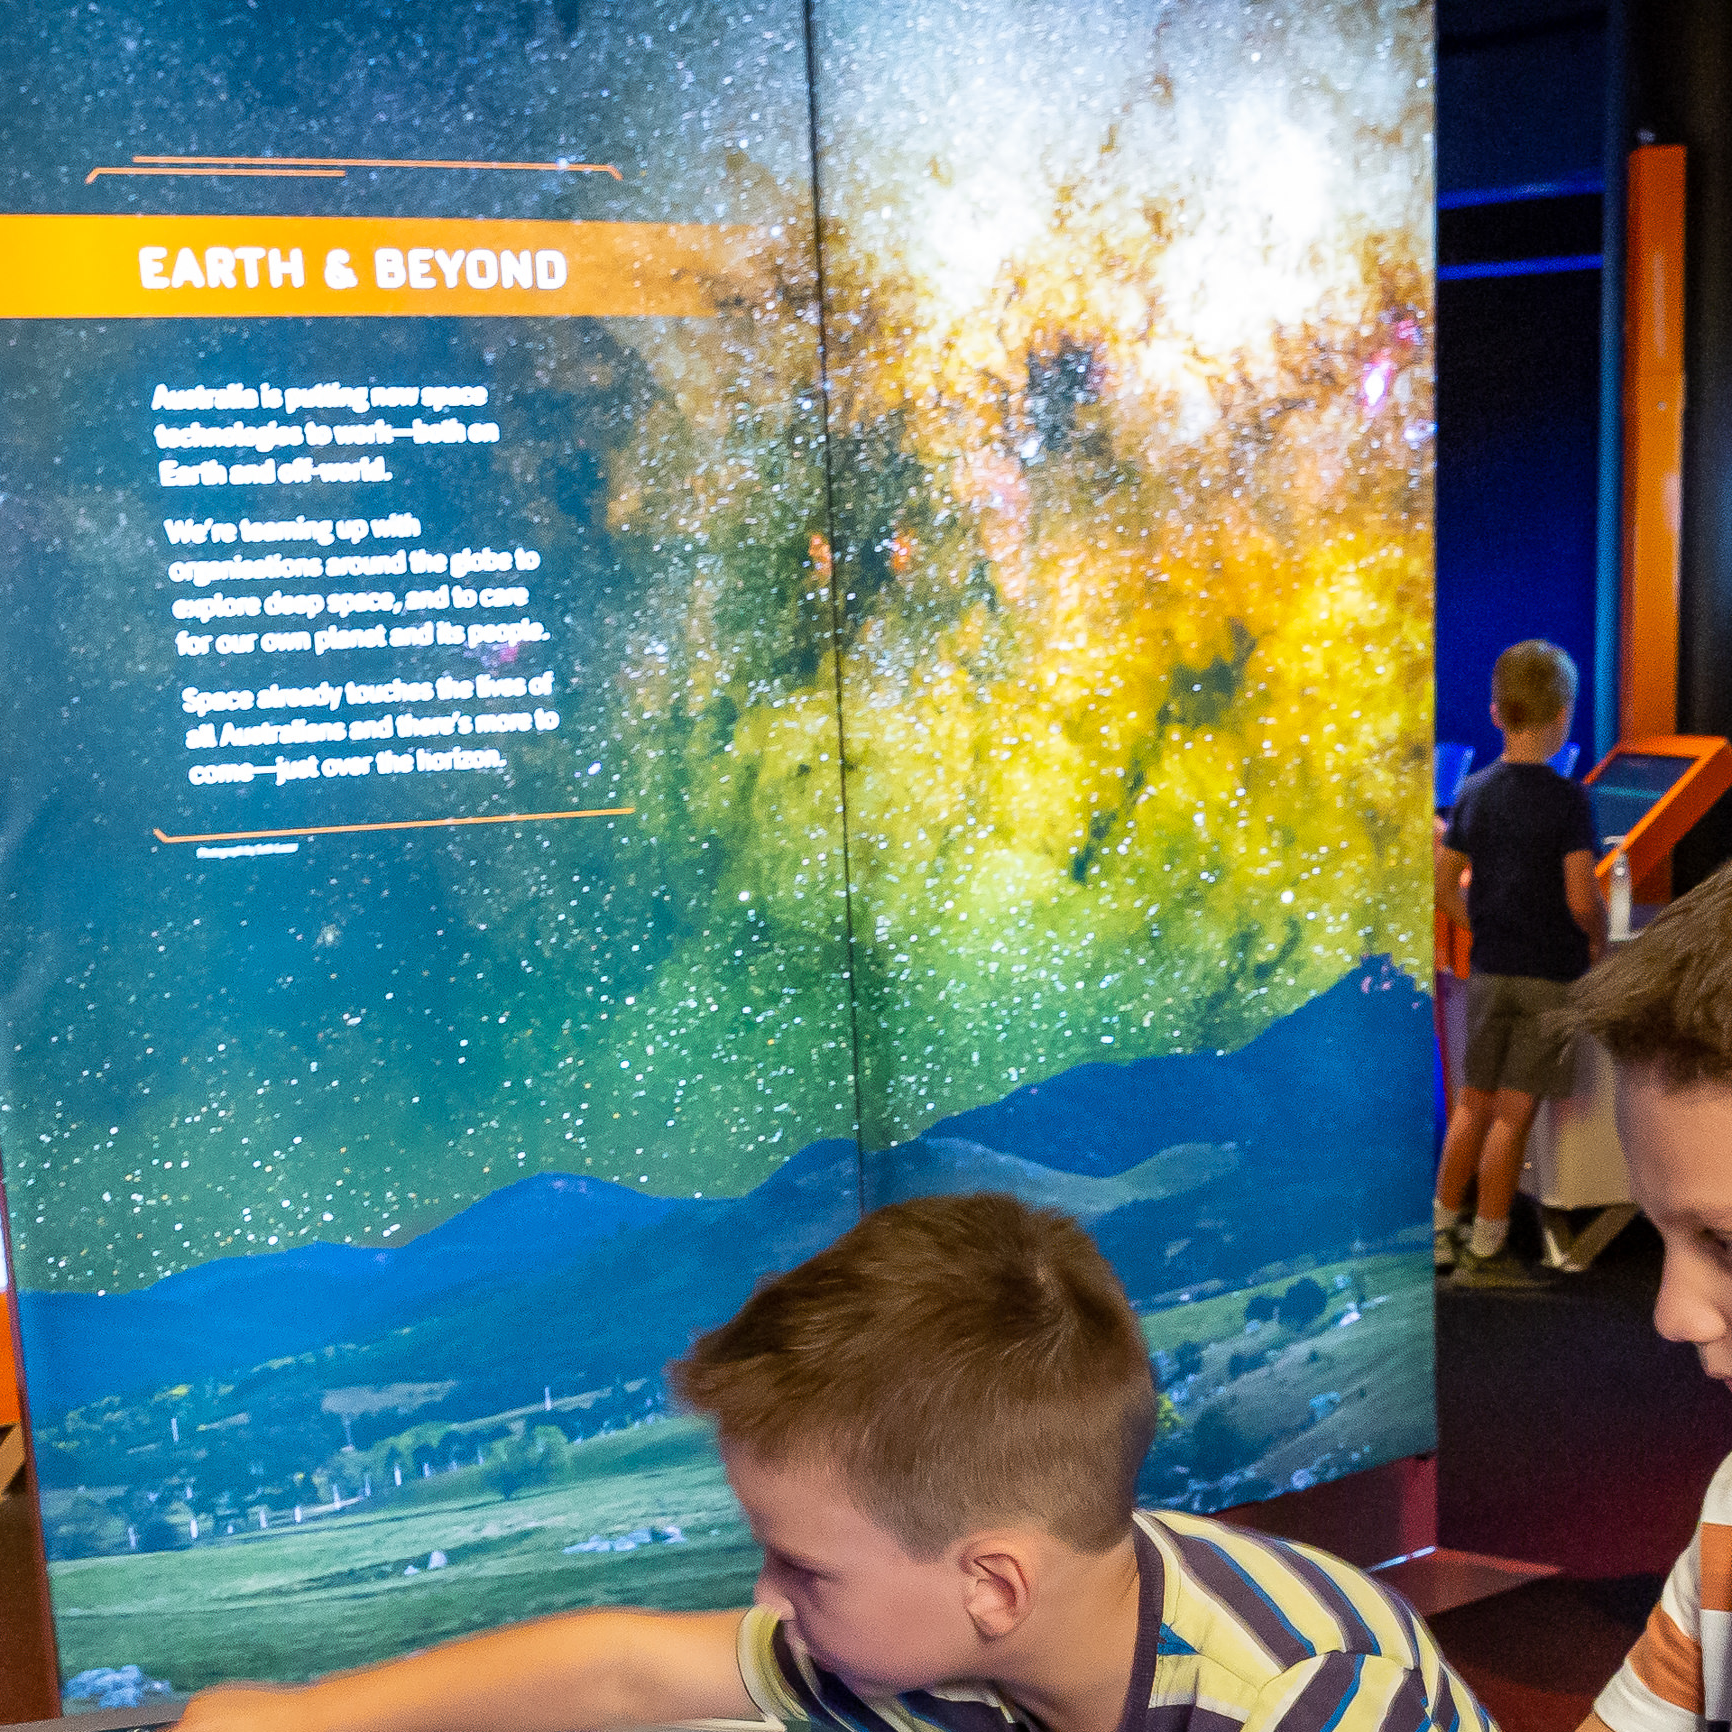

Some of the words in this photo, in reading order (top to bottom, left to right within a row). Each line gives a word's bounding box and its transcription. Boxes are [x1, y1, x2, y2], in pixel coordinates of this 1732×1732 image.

[139, 246, 305, 290] EARTH
[324, 248, 358, 290] &
[374, 247, 567, 290] BEYOND
[151, 382, 259, 411] Australia
[260, 382, 283, 409] is
[284, 381, 370, 414] putting
[370, 386, 419, 407] new
[420, 386, 488, 412] space
[153, 420, 304, 452] technologies
[304, 421, 333, 446] to
[467, 422, 500, 443] on
[158, 459, 228, 486] Earth
[228, 458, 276, 485] and
[277, 455, 393, 484] off-world.
[239, 515, 335, 546] teaming
[335, 518, 369, 544] up
[370, 512, 421, 538] with
[168, 553, 323, 587] organisations
[325, 549, 407, 576] around
[408, 549, 448, 574] the
[450, 547, 513, 578] globe
[514, 547, 540, 570] to
[171, 592, 262, 623] explore
[263, 590, 325, 619] deep
[327, 591, 403, 618] space,
[405, 584, 450, 610] and
[451, 585, 478, 608] to
[479, 587, 529, 607] care
[175, 630, 213, 656] for
[215, 633, 259, 654] our
[260, 631, 311, 652] own
[314, 624, 388, 655] planet
[389, 621, 434, 647] and
[436, 621, 466, 645] its
[467, 617, 551, 649] people.
[181, 687, 255, 717] Space
[256, 681, 343, 711] already
[344, 678, 434, 704] touches
[435, 676, 474, 700] the
[475, 674, 527, 698] lives
[528, 670, 554, 696] of
[185, 722, 218, 749] all
[219, 718, 347, 747] Australians
[348, 714, 394, 740] and
[474, 712, 533, 733] more
[533, 707, 560, 731] to
[321, 756, 374, 777] over
[375, 750, 414, 774] the
[416, 746, 507, 772] horizon.
